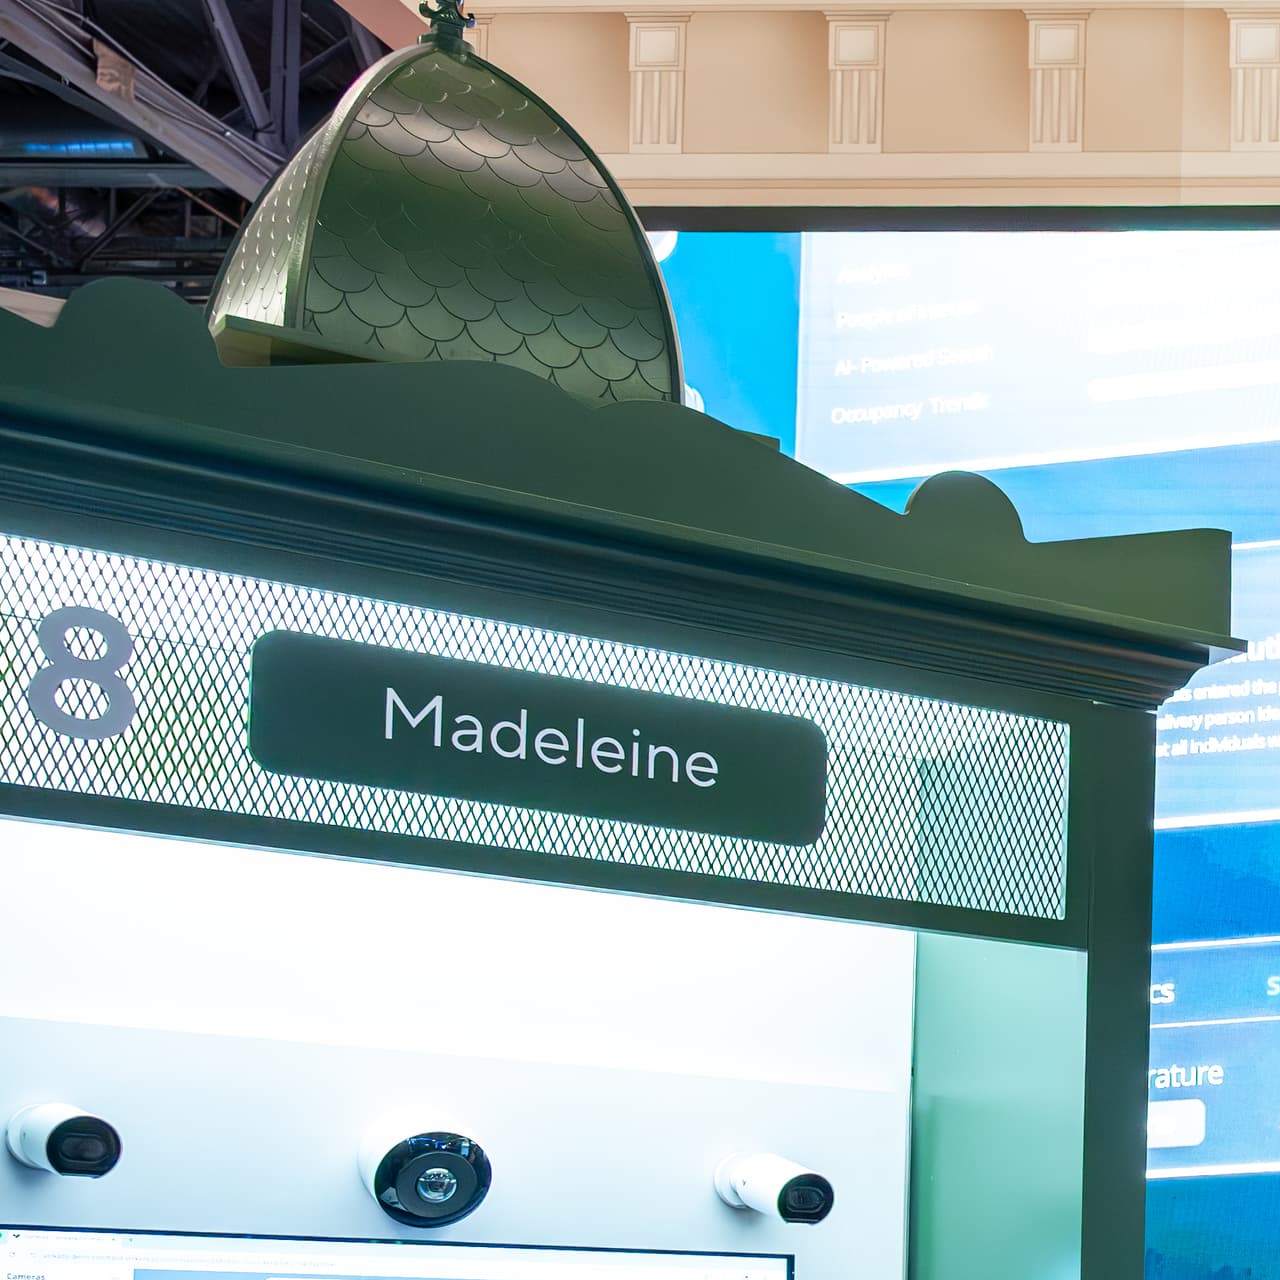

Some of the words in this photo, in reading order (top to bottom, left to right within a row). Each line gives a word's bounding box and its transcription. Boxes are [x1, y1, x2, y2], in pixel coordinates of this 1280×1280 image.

[29, 605, 136, 740] 8
[384, 686, 720, 789] Madeleine
[7, 1272, 46, 1280] Cameras
